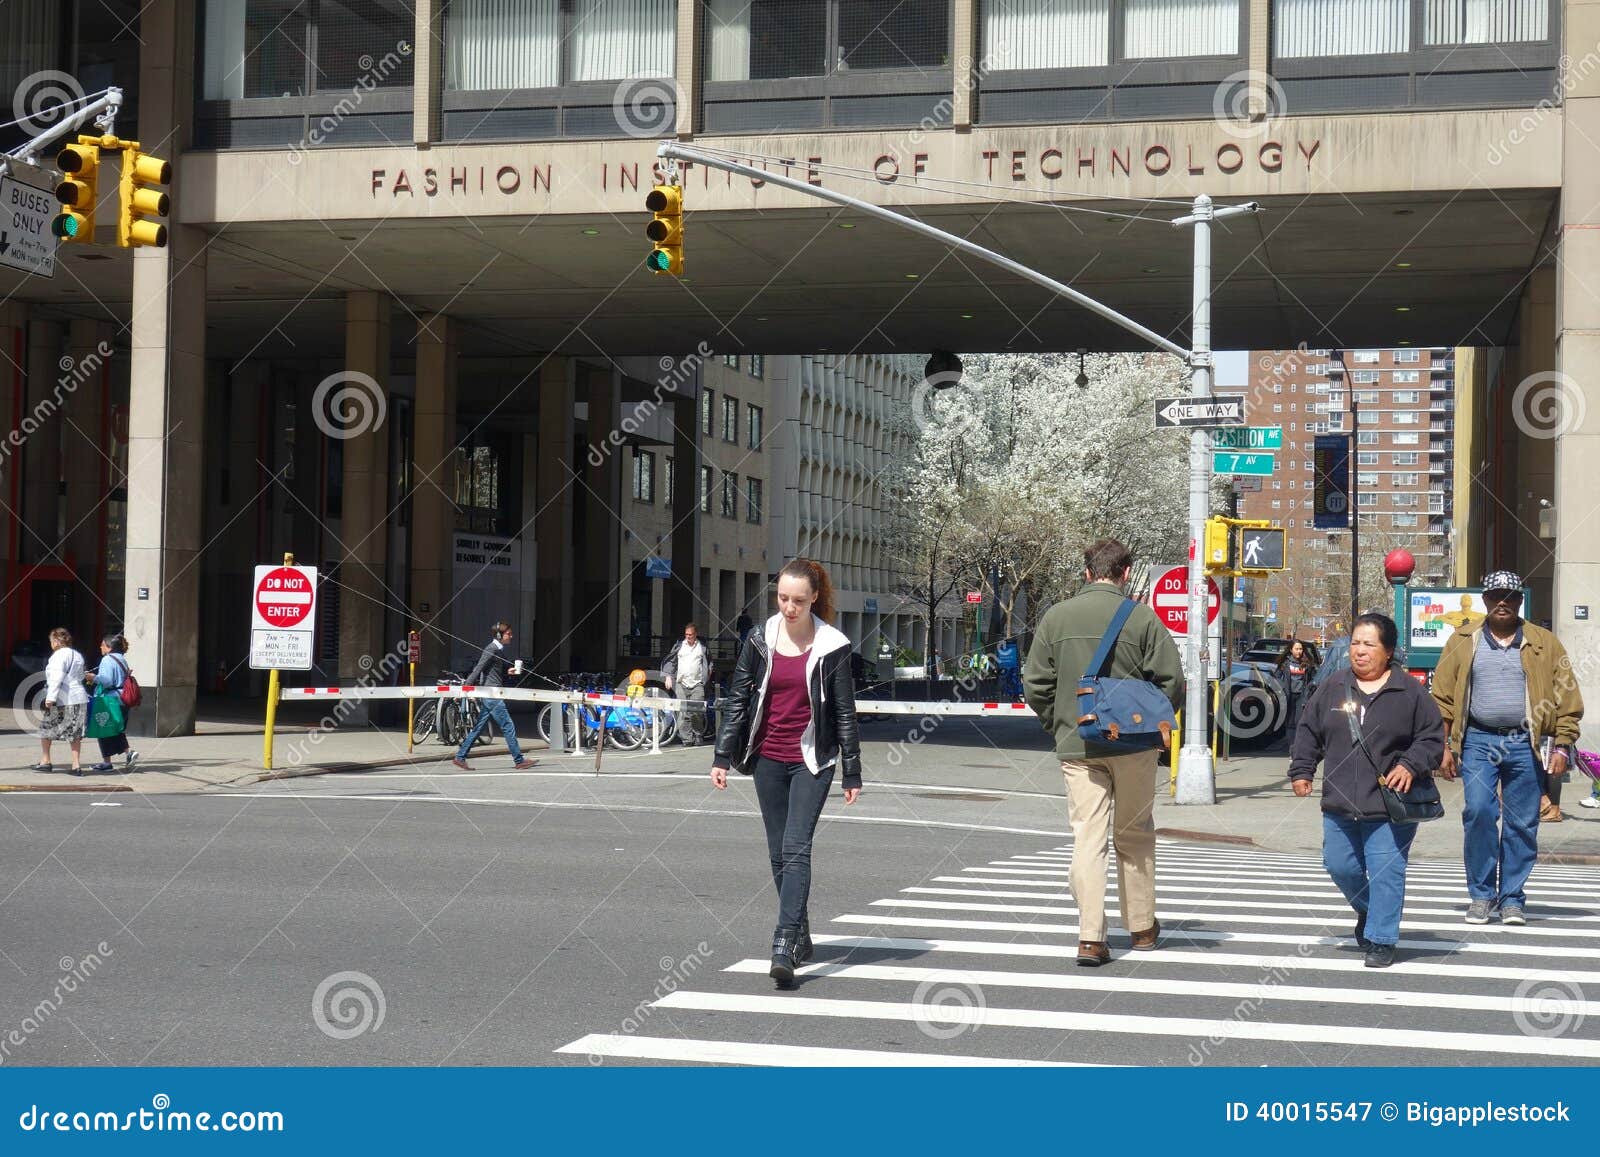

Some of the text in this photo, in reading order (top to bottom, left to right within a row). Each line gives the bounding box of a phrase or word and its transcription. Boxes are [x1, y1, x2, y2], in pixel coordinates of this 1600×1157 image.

[372, 140, 1320, 200] FASHION INSTITUTE OF TECHNOLOGY
[12, 188, 49, 214] BUSES
[13, 212, 44, 235] ONLY
[11, 247, 25, 261] MON
[1168, 405, 1233, 418] ONE WAY
[1214, 429, 1280, 447] FASHION AVE
[1230, 455, 1257, 472] 7 AV
[267, 578, 304, 589] DO NOT
[1165, 579, 1181, 591] DO
[267, 607, 300, 617] ENTER
[1167, 611, 1188, 622] ENT
[1414, 629, 1437, 637] Brick
[265, 643, 279, 651] MON
[287, 643, 299, 651] FRI
